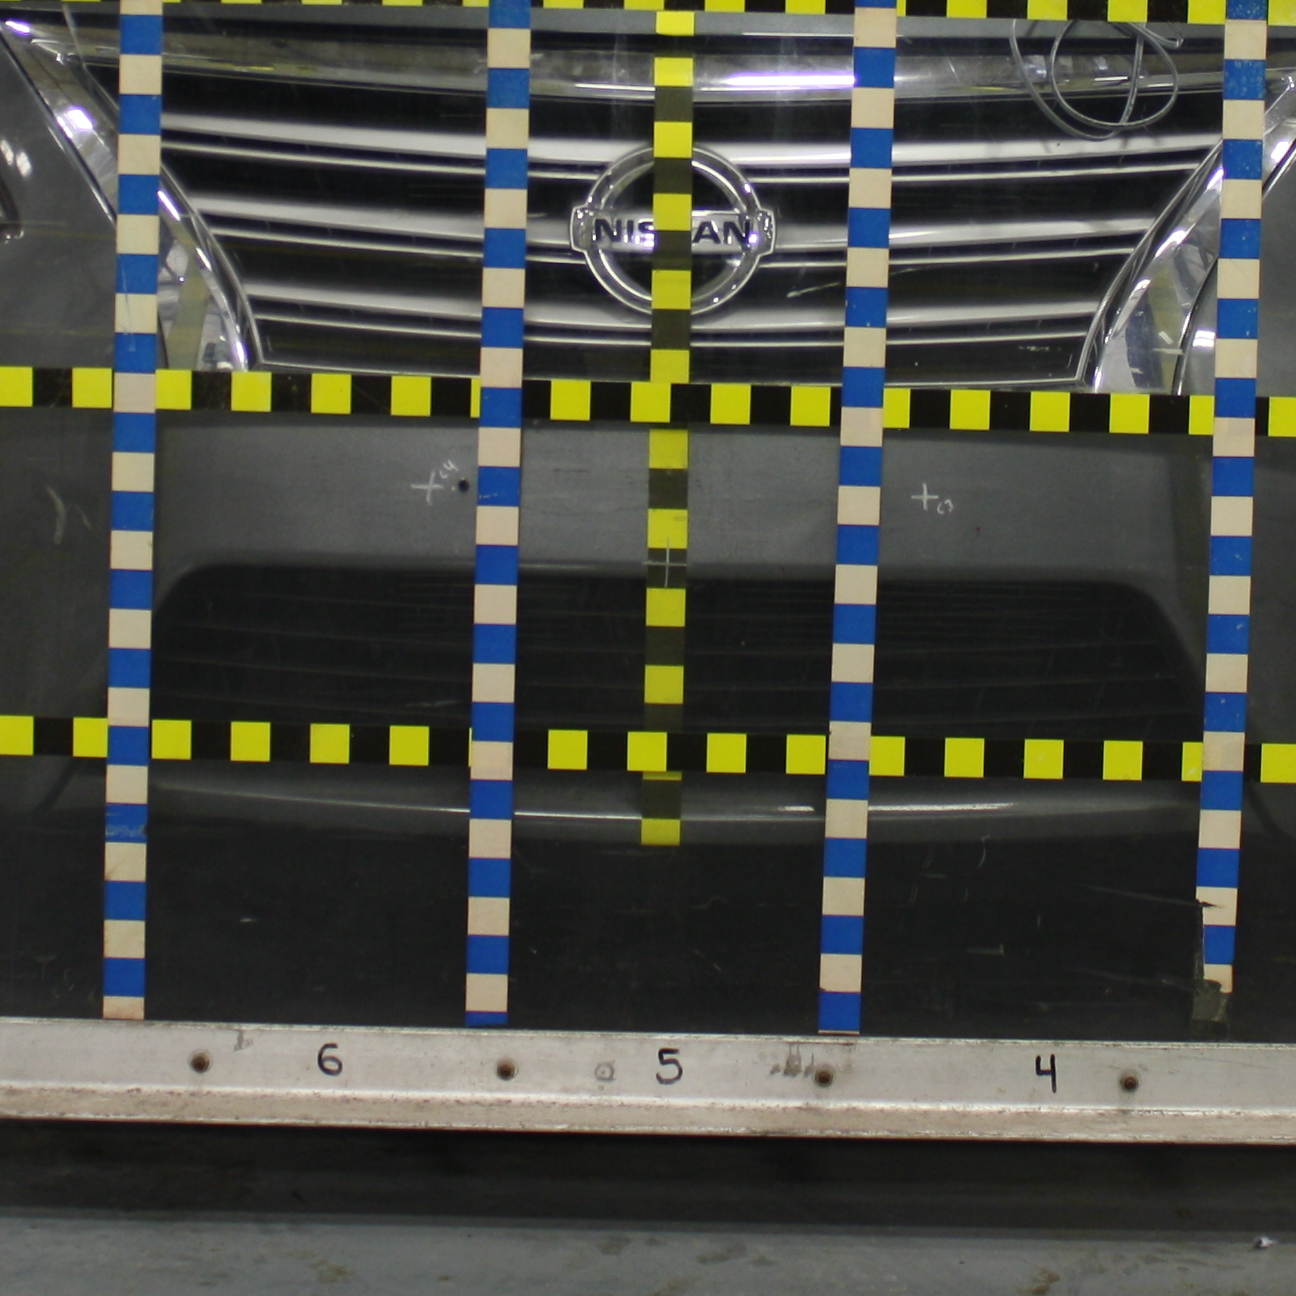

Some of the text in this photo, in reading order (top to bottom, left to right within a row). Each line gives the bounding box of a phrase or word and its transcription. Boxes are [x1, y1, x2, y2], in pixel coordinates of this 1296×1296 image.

[593, 218, 752, 245] NISAN
[316, 1043, 343, 1075] 6
[655, 1048, 683, 1085] 5
[1035, 1054, 1057, 1093] 4
